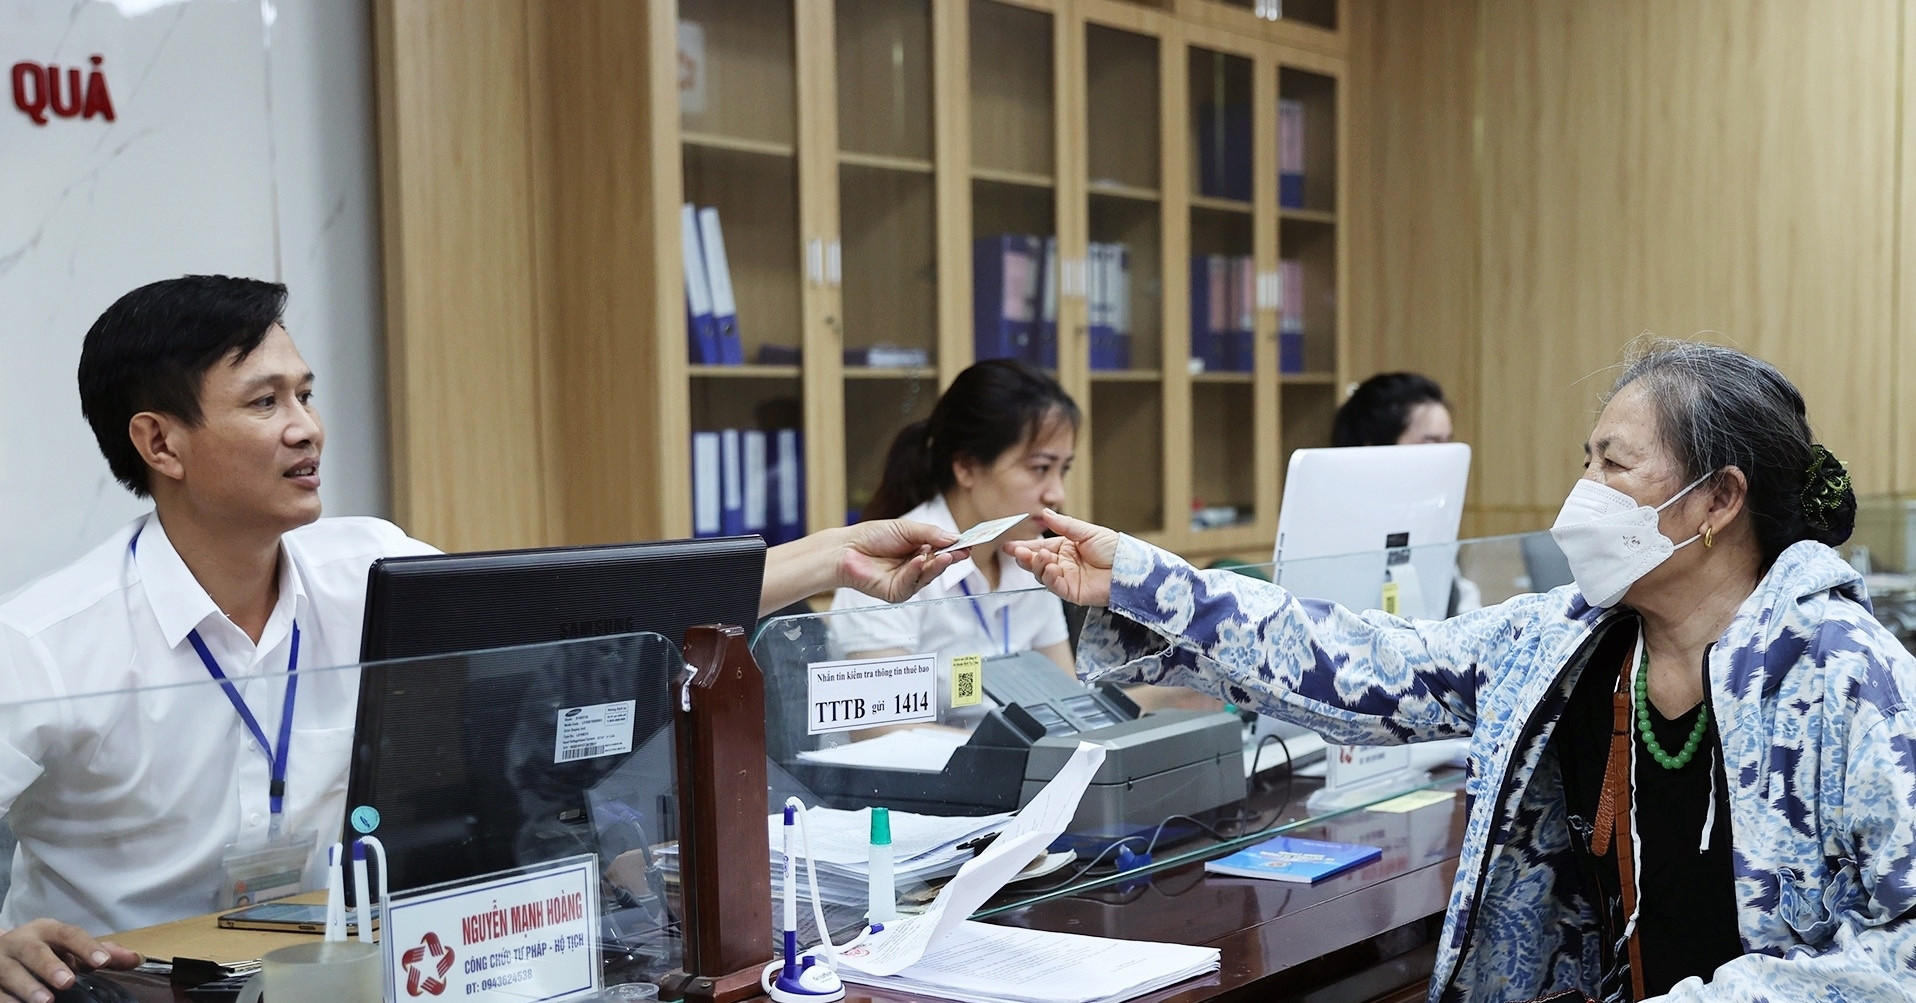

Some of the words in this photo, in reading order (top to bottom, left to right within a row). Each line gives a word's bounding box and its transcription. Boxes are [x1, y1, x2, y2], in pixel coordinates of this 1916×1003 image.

[11, 53, 116, 125] QUẢ
[836, 671, 846, 681] tin
[847, 667, 863, 680] kiểm
[875, 668, 893, 678] thông
[893, 666, 903, 675] tin
[903, 665, 917, 674] thuê
[918, 665, 930, 673] bao
[815, 698, 866, 723] TTTB
[894, 691, 929, 714] 1414
[462, 899, 508, 946] NGUYỄN
[511, 900, 544, 938] MẠNH
[546, 889, 583, 926] HOÀNG
[464, 956, 488, 975] CÔNG
[490, 947, 512, 969] CHỨC
[513, 946, 525, 962] TƯ
[526, 940, 547, 960] PHÁP
[554, 934, 566, 954] HỘ
[567, 933, 584, 952] TỊCH
[466, 982, 480, 995] ĐT:
[481, 968, 533, 991] 0943624538
